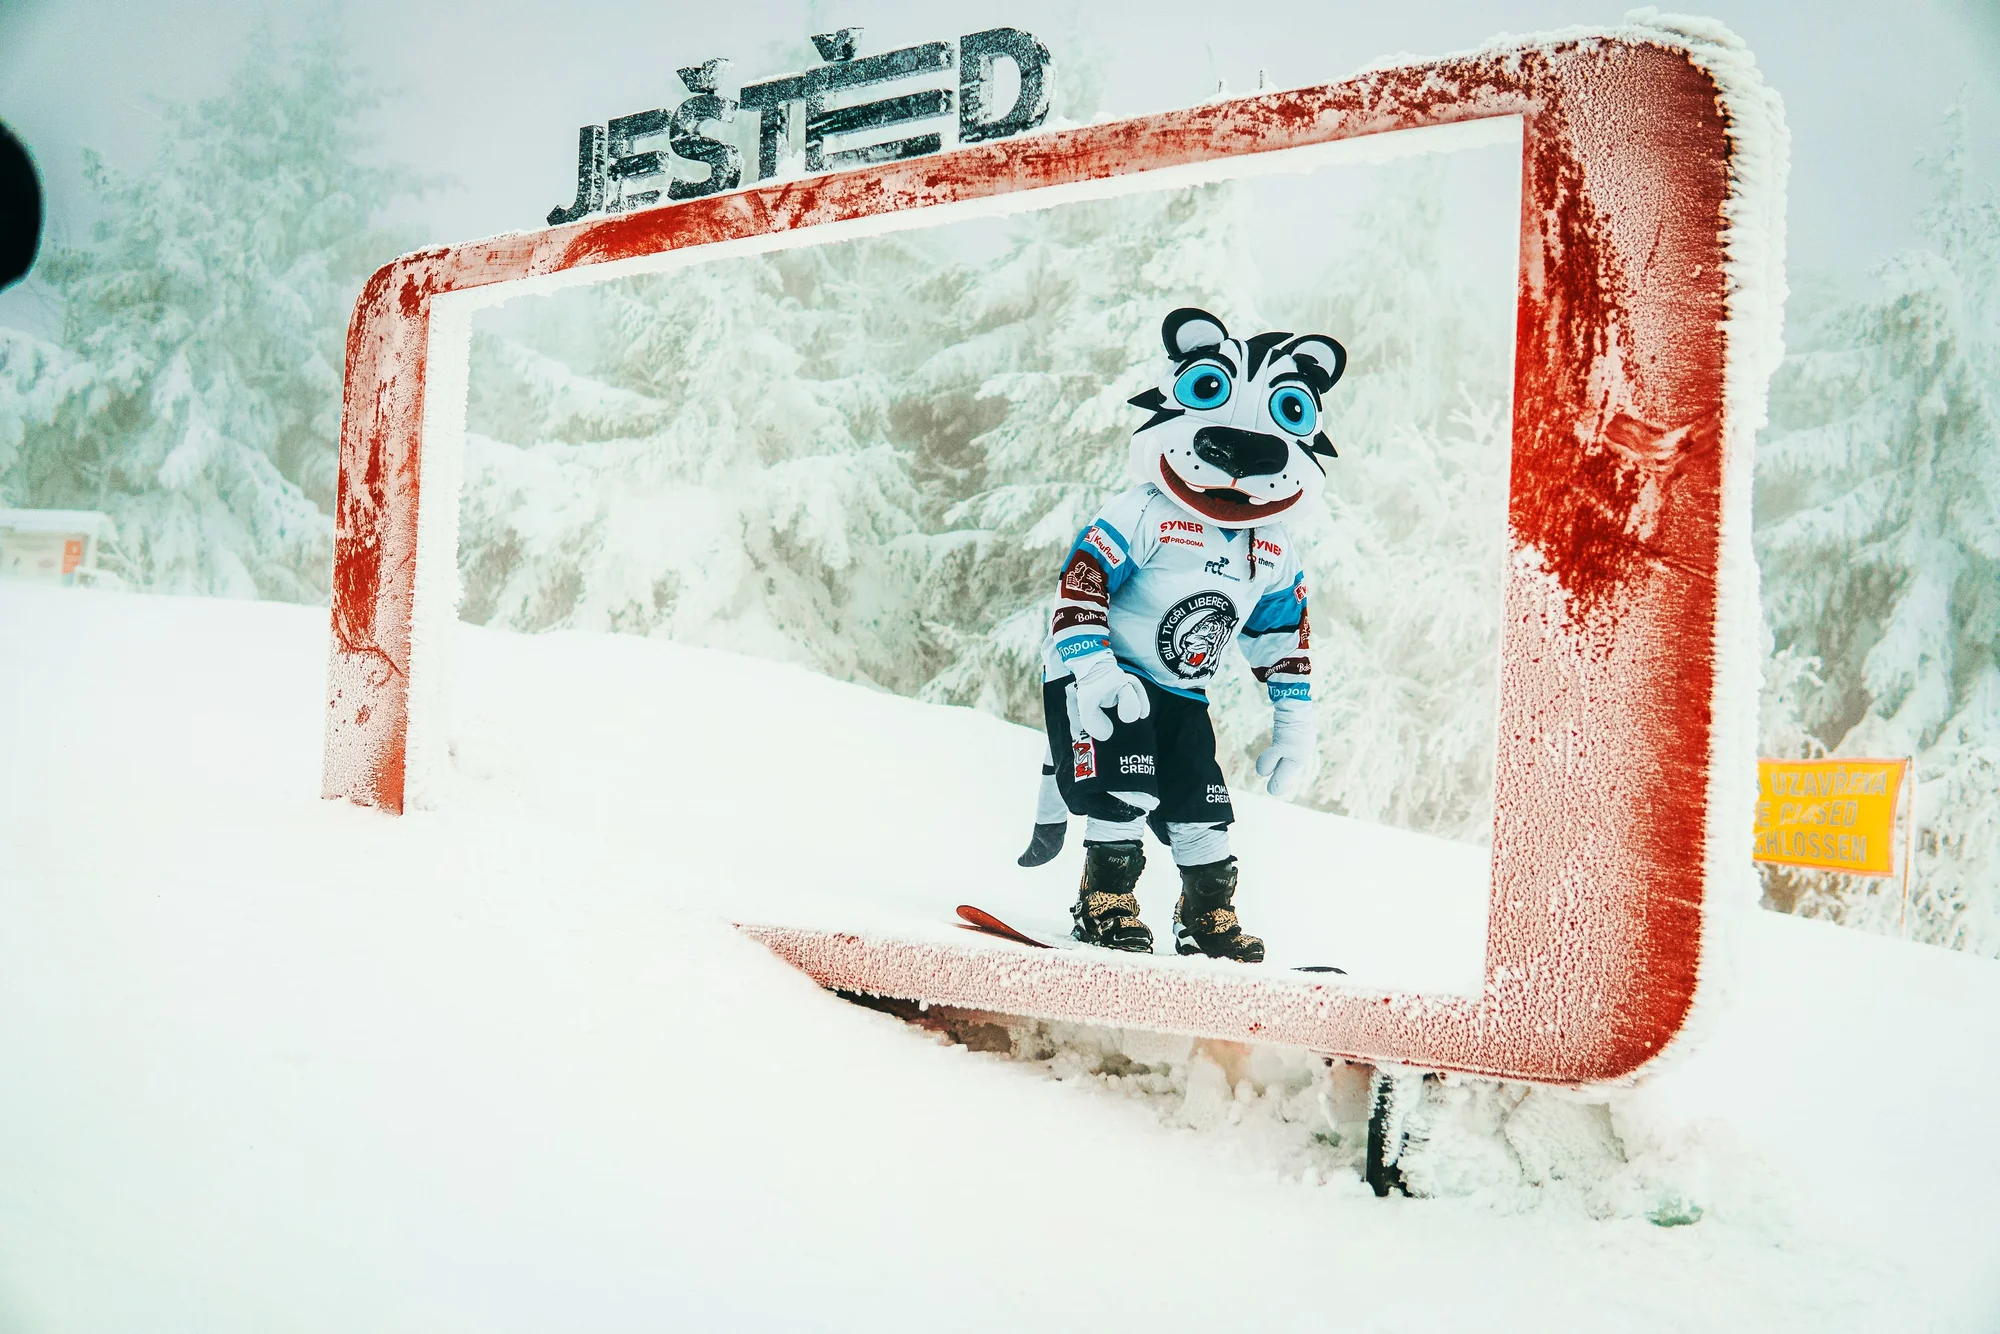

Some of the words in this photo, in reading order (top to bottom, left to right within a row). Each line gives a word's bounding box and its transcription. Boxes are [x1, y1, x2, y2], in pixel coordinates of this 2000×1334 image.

[546, 27, 1056, 225] JEŠTĚD
[1160, 520, 1204, 534] SYNER
[1094, 535, 1120, 566] Kaufland
[1170, 537, 1205, 548] PRO-DOMA
[1251, 538, 1282, 556] SYNE
[1204, 560, 1225, 576] FCC
[1162, 607, 1187, 635] TYGŘI
[1188, 595, 1229, 611] LIBEREC
[1119, 754, 1155, 766] HOME
[1120, 764, 1156, 775] CREDIT
[1206, 784, 1228, 794] HOM
[1770, 765, 1888, 797] UZAVŘENA
[1753, 830, 1868, 863] CHLOSSEN
